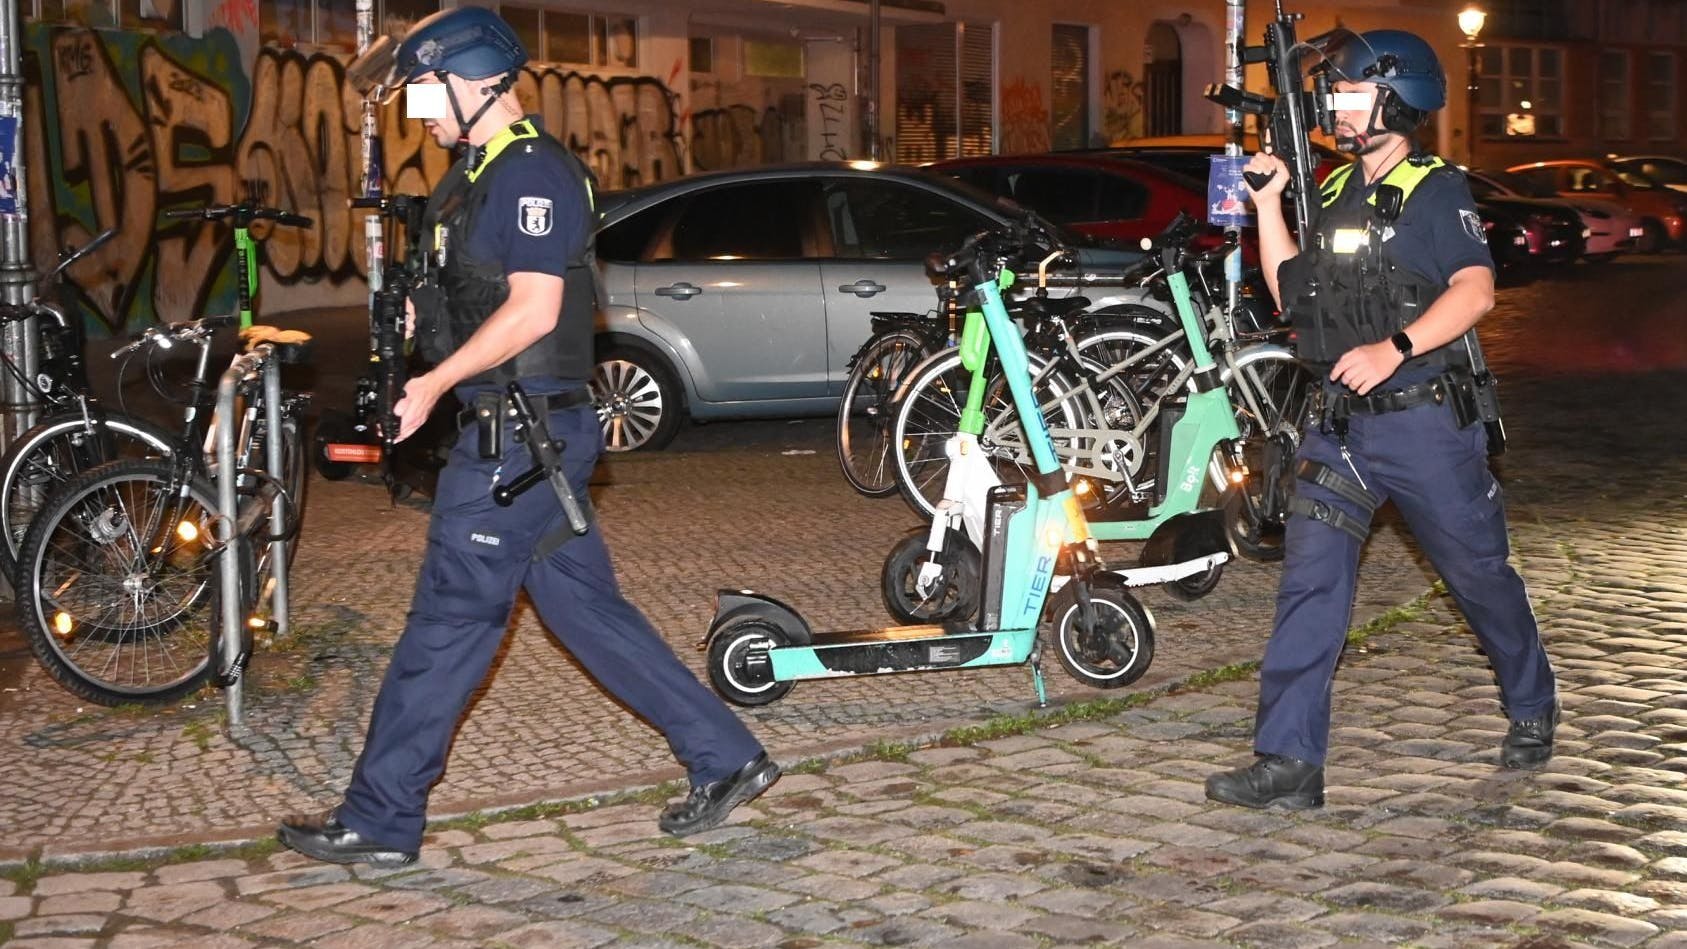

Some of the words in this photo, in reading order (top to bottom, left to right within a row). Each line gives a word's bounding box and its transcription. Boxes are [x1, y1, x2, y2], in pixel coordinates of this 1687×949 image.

[1181, 465, 1200, 492] Bolt
[993, 508, 1004, 536] TIER
[471, 533, 500, 546] POLIZEI
[1023, 555, 1053, 616] TIER
